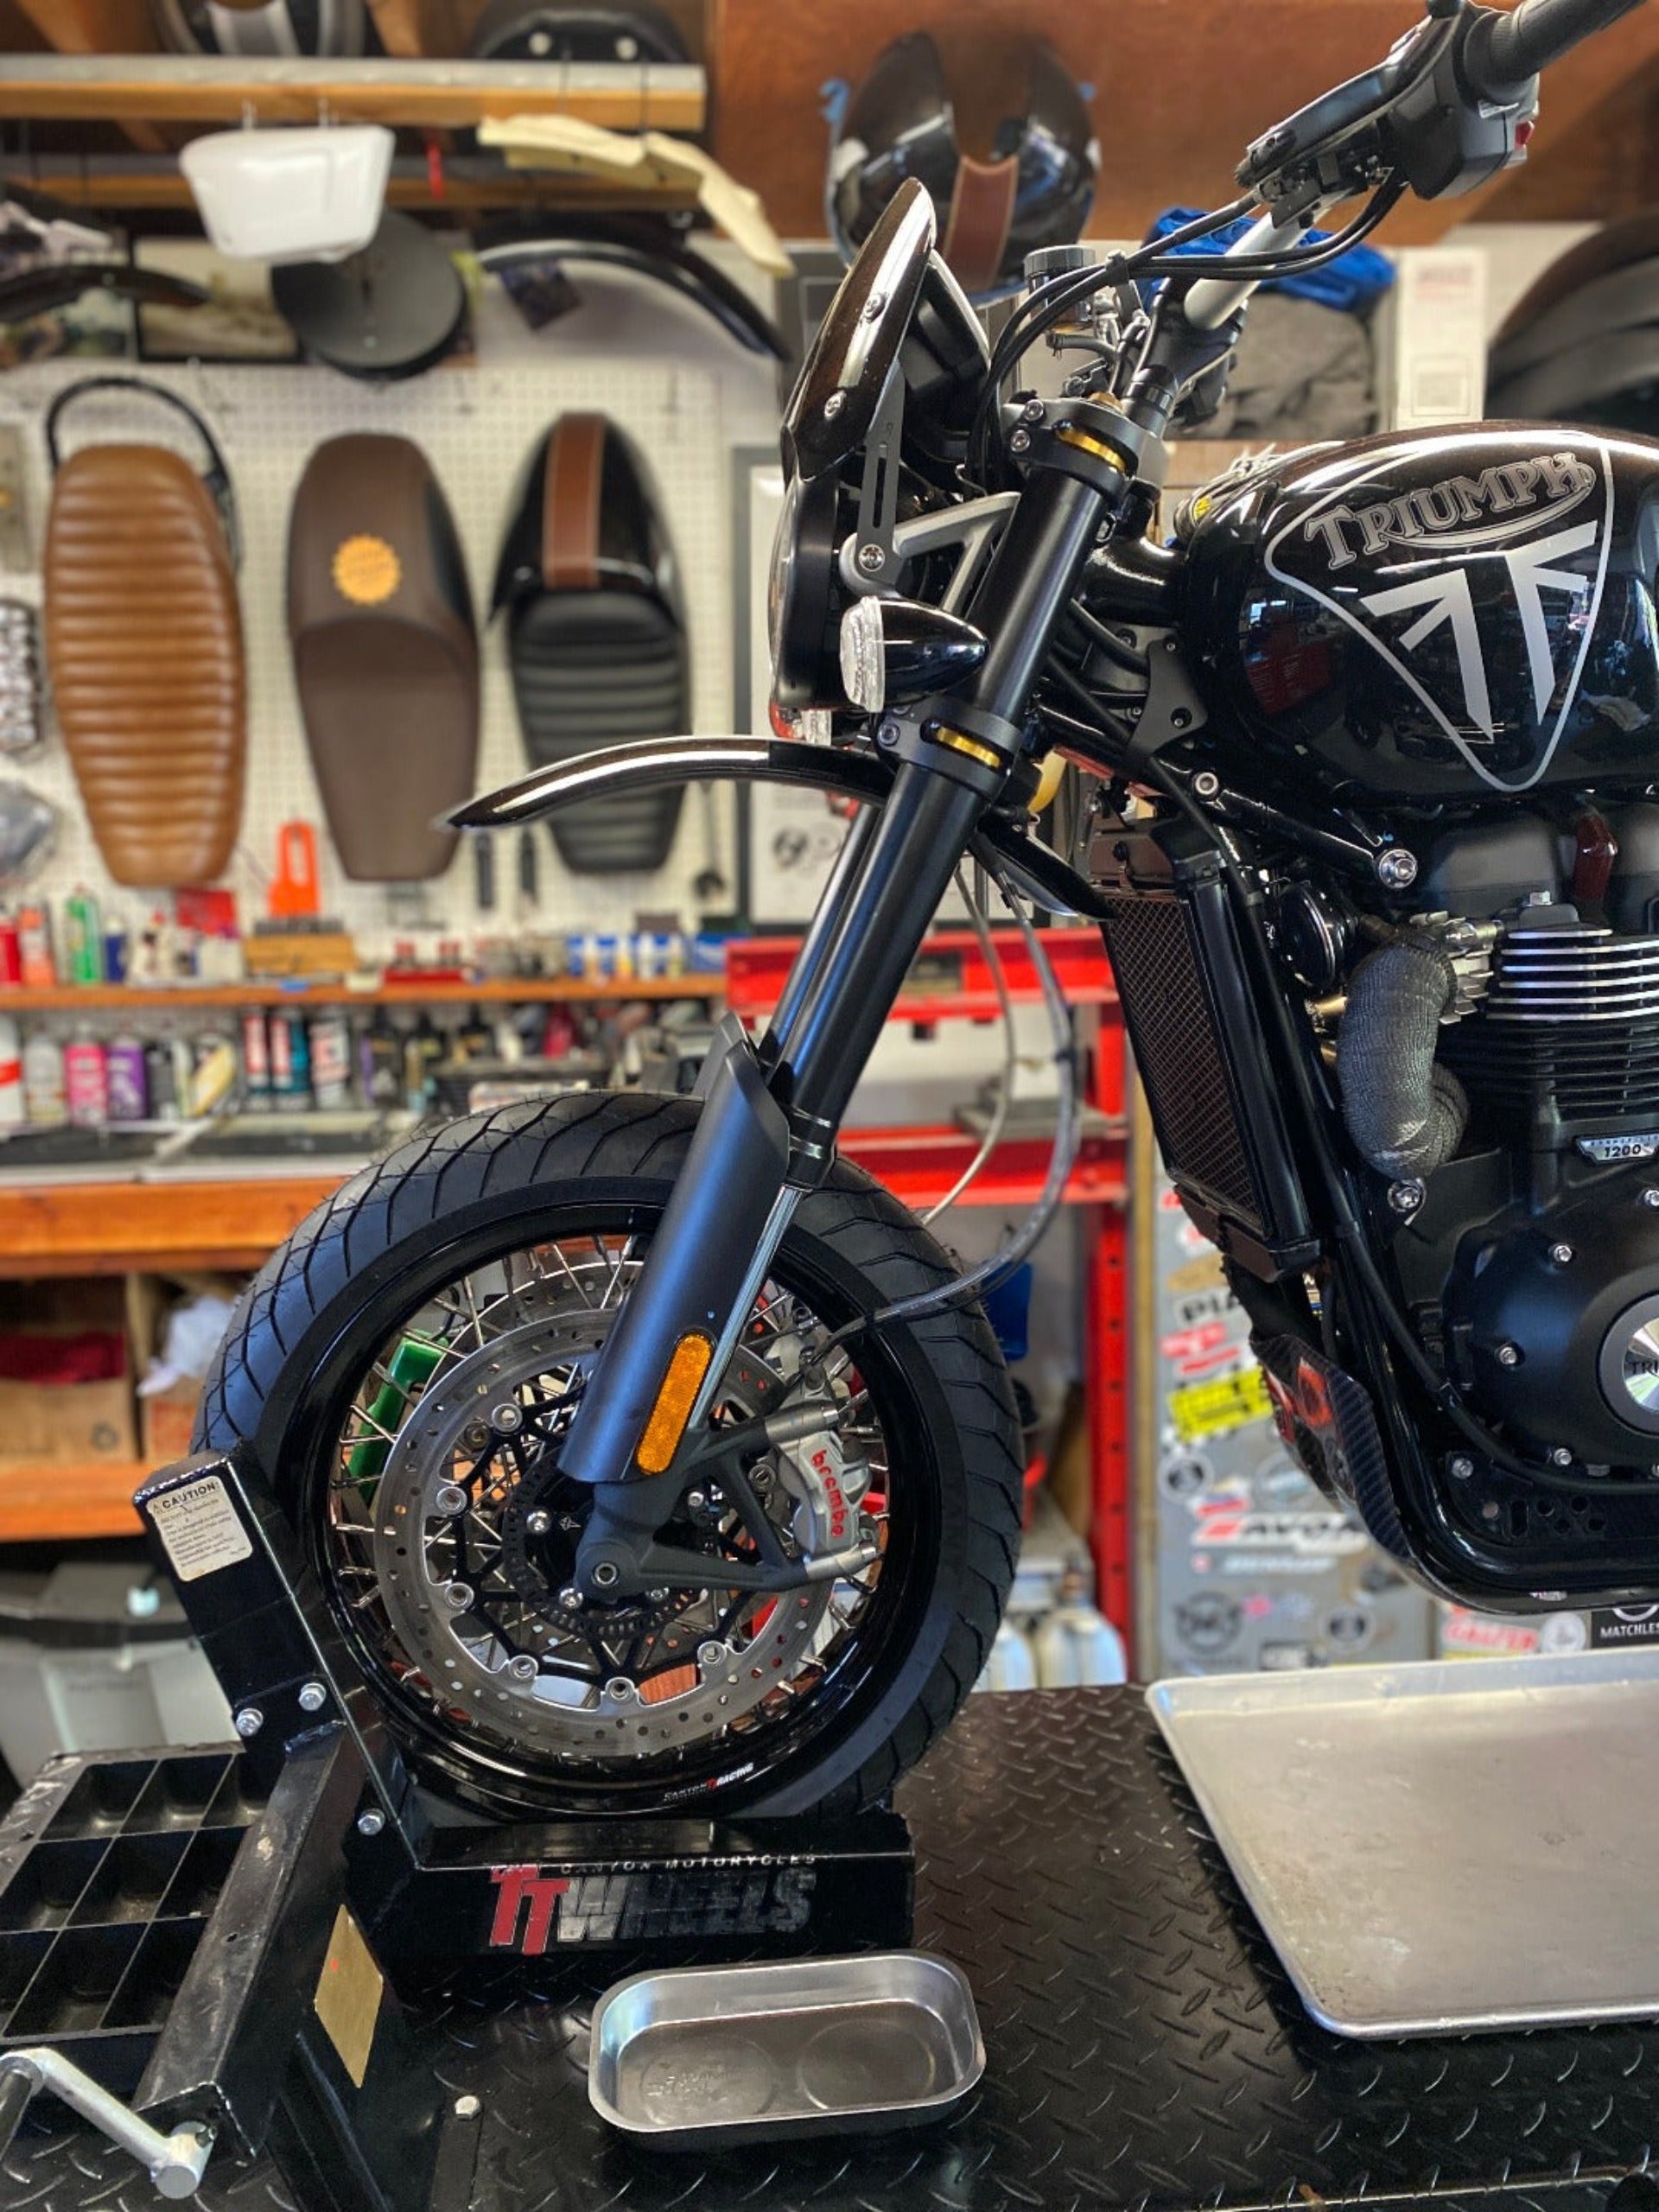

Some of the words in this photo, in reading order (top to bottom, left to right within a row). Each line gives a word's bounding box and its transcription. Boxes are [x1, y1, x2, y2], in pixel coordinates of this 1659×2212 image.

[1304, 453, 1597, 570] TRIUMPH
[1605, 1143, 1642, 1157] 1200
[162, 1481, 216, 1509] CAUTION
[811, 1450, 848, 1536] brembo
